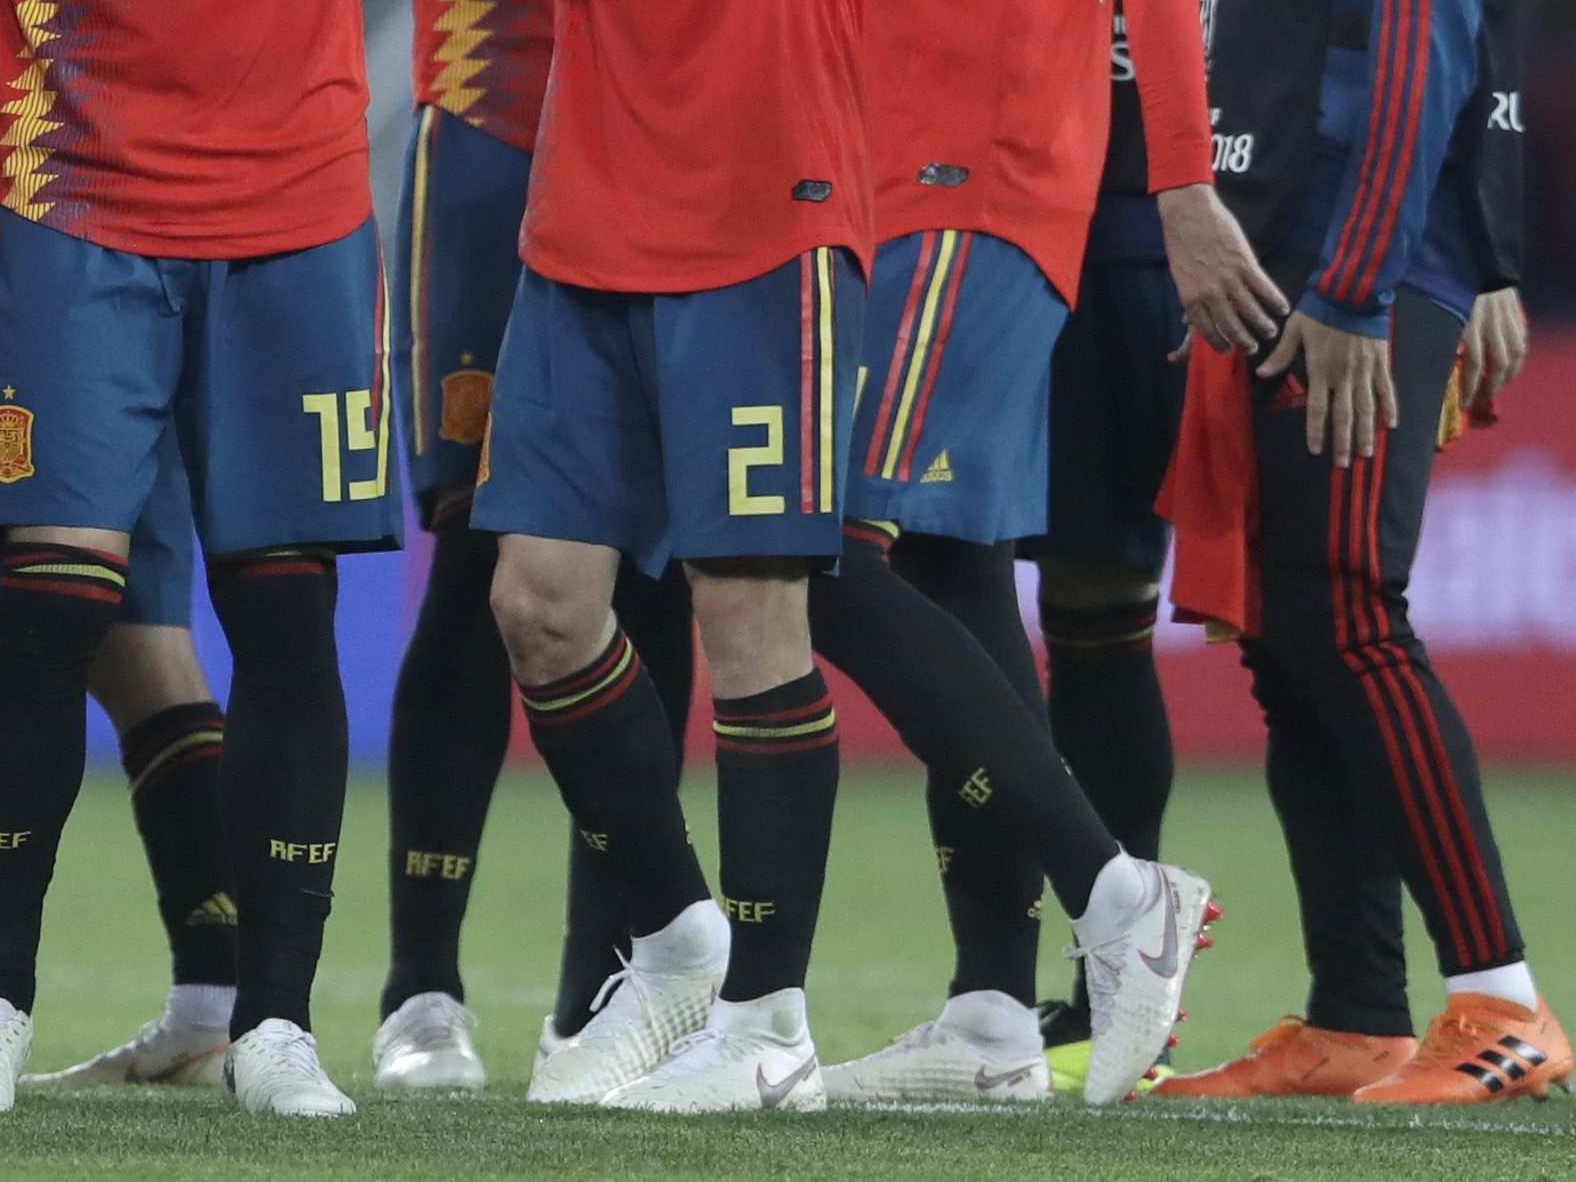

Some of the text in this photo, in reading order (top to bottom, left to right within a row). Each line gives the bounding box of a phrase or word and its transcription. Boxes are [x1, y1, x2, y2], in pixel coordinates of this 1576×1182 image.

[302, 388, 386, 502] 15
[727, 405, 786, 516] 2
[269, 838, 337, 864] RFEF
[404, 849, 472, 882] RFEF
